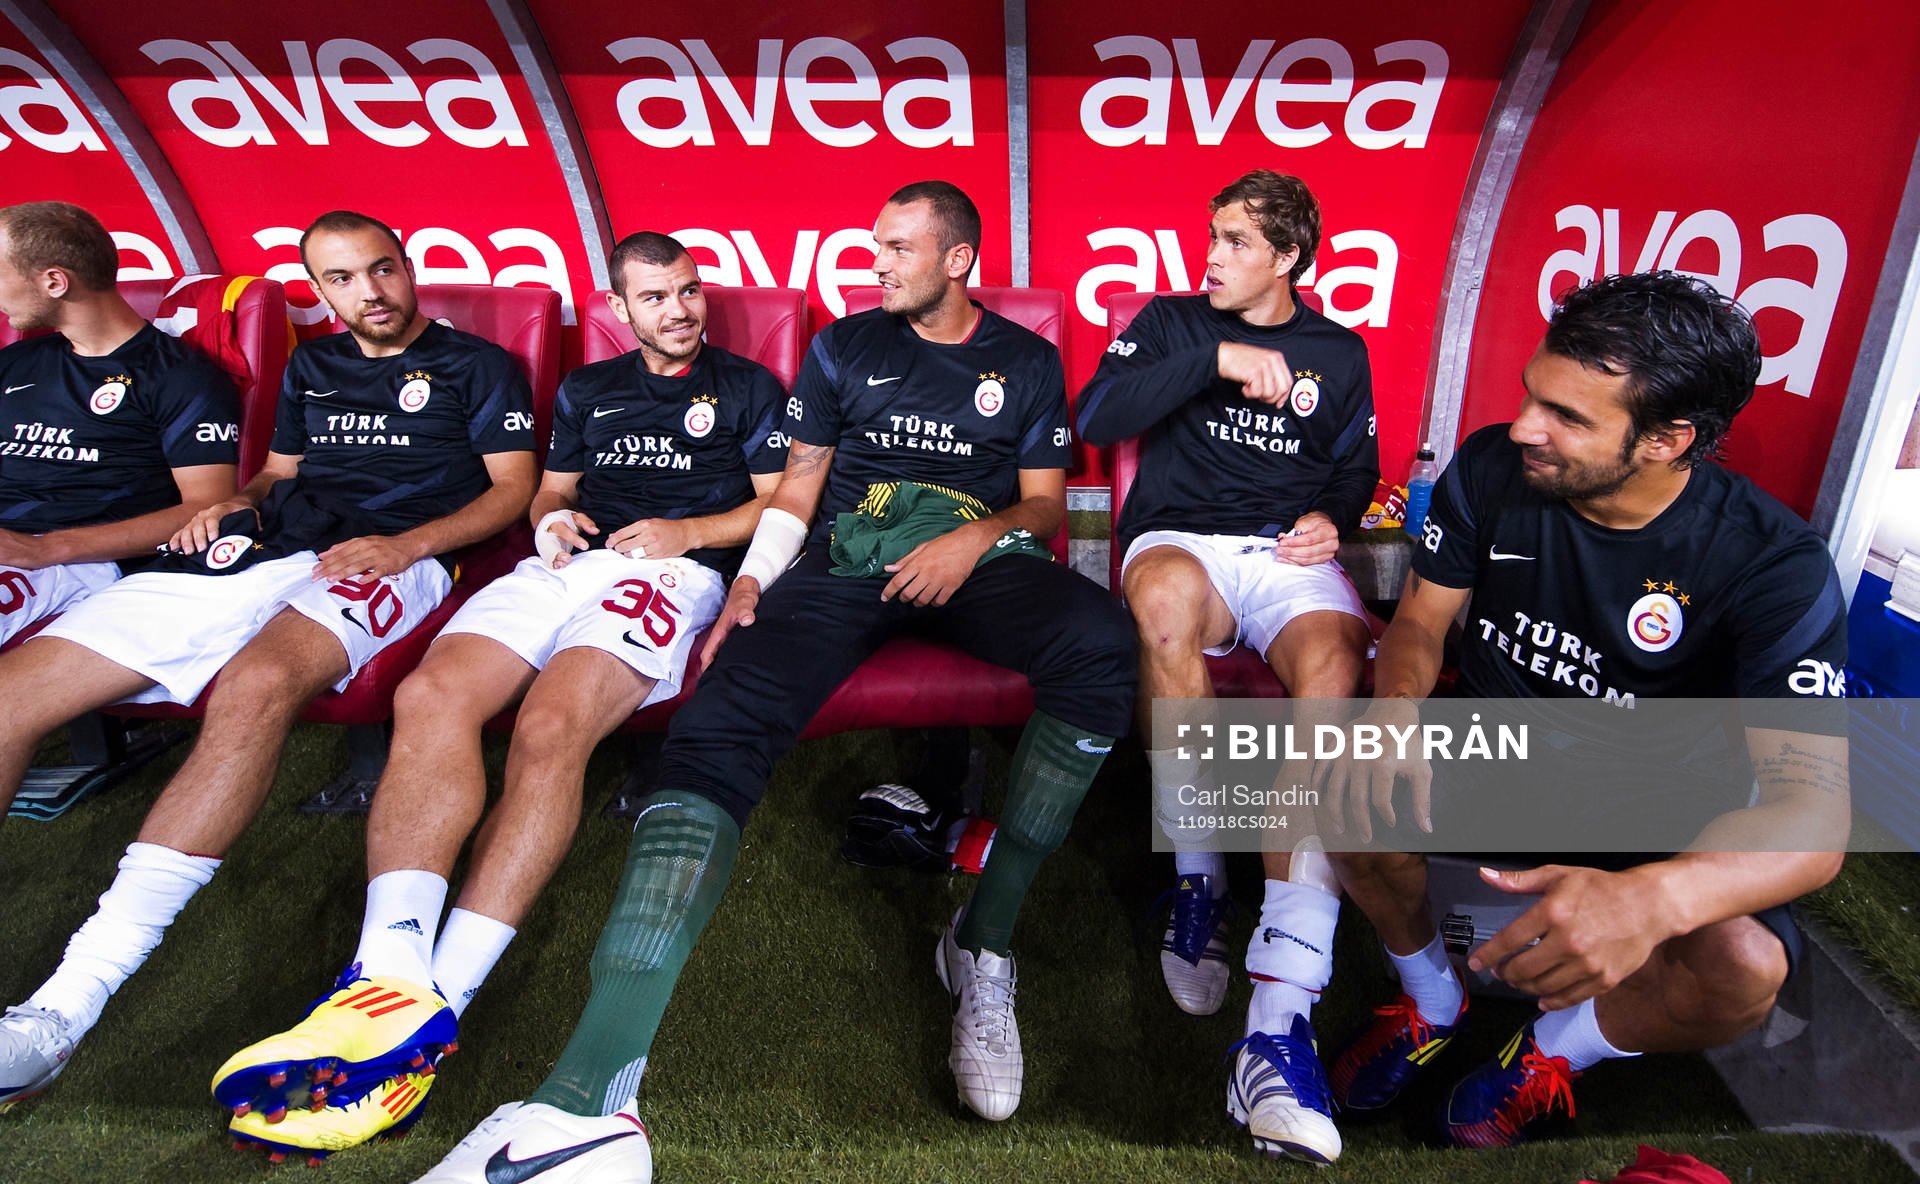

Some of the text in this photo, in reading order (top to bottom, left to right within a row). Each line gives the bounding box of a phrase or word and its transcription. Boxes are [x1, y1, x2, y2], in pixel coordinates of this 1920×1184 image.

[139, 38, 529, 148] avea
[606, 36, 974, 148] avea
[1080, 35, 1450, 150] avea
[14, 422, 74, 445] TÜRK
[326, 413, 388, 431] TÜRK
[890, 414, 955, 440] TÜRK
[1225, 406, 1286, 434] TÜRK
[594, 452, 692, 470] TELEKOM
[865, 432, 973, 456] TELEKOM
[601, 578, 682, 648] 35
[1478, 618, 1636, 710] TELEKOM
[1514, 611, 1603, 675] TÜRK
